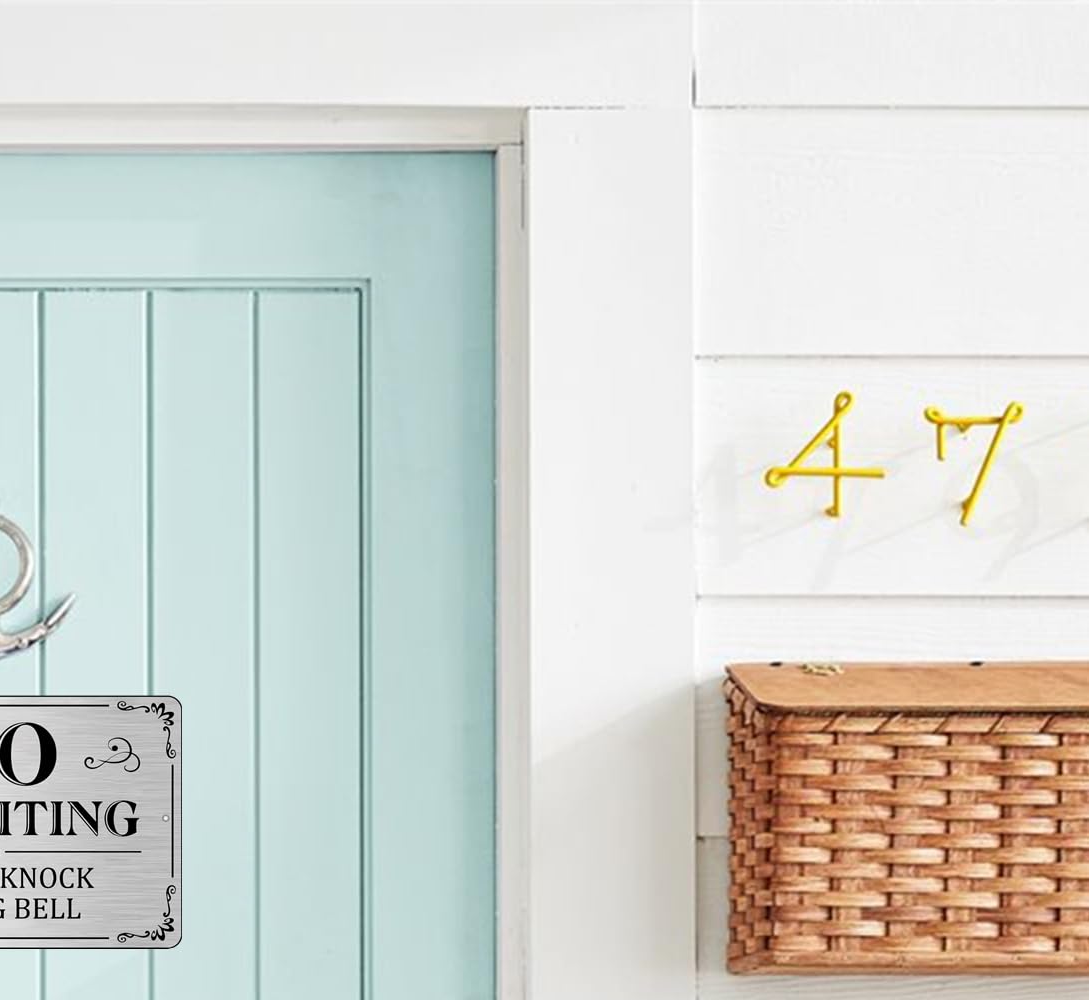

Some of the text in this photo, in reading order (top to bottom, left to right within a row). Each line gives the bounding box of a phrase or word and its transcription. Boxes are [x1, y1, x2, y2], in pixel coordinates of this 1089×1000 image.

[765, 391, 1023, 526] 47
[0, 867, 95, 889] KNOCK
[14, 897, 82, 920] BELL
